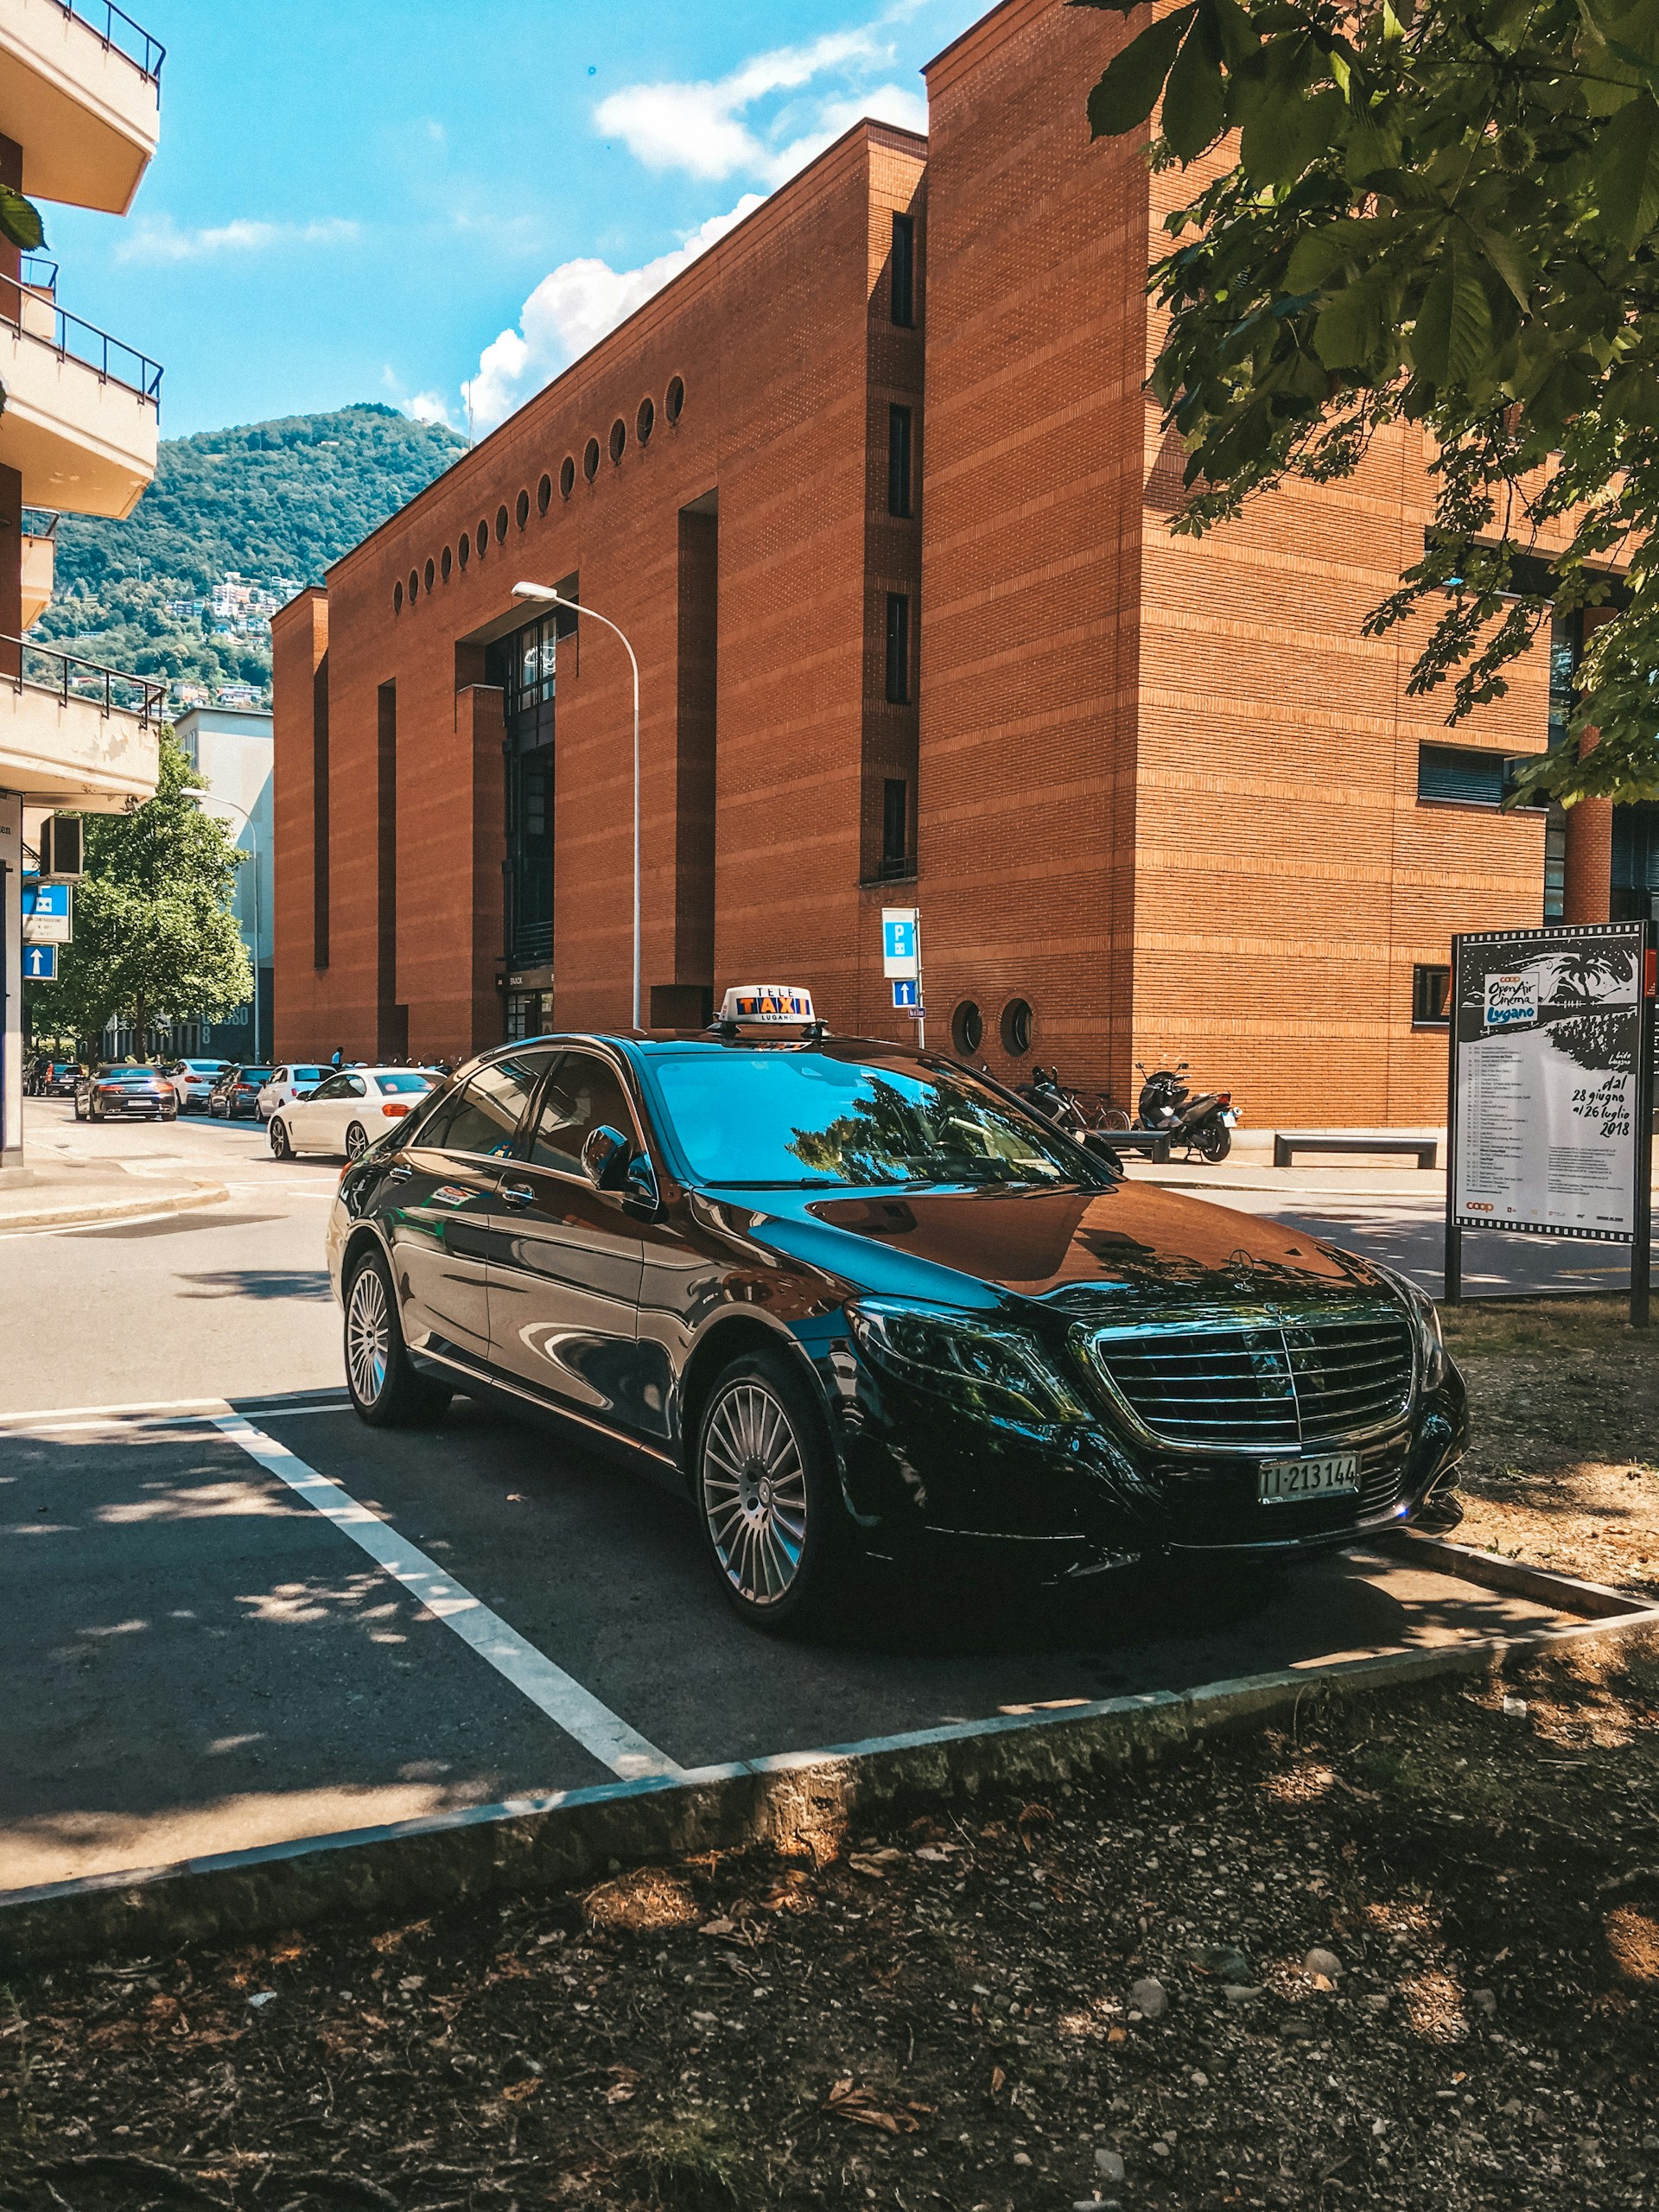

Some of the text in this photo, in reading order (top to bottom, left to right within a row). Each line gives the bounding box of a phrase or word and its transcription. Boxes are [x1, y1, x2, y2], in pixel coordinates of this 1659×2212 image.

[894, 924, 905, 941] P
[756, 987, 794, 997] TELE
[1489, 993, 1535, 1007] Cinema
[740, 997, 808, 1015] TAXI
[1486, 1007, 1535, 1024] Lugano
[201, 1026, 211, 1045] 8
[1608, 1053, 1631, 1070] Lugano
[1602, 1074, 1628, 1091] dal
[1572, 1089, 1624, 1107] 28 giugno
[1573, 1104, 1630, 1122] al 26 luglio
[1599, 1122, 1630, 1138] 2018
[1465, 1201, 1494, 1213] coop
